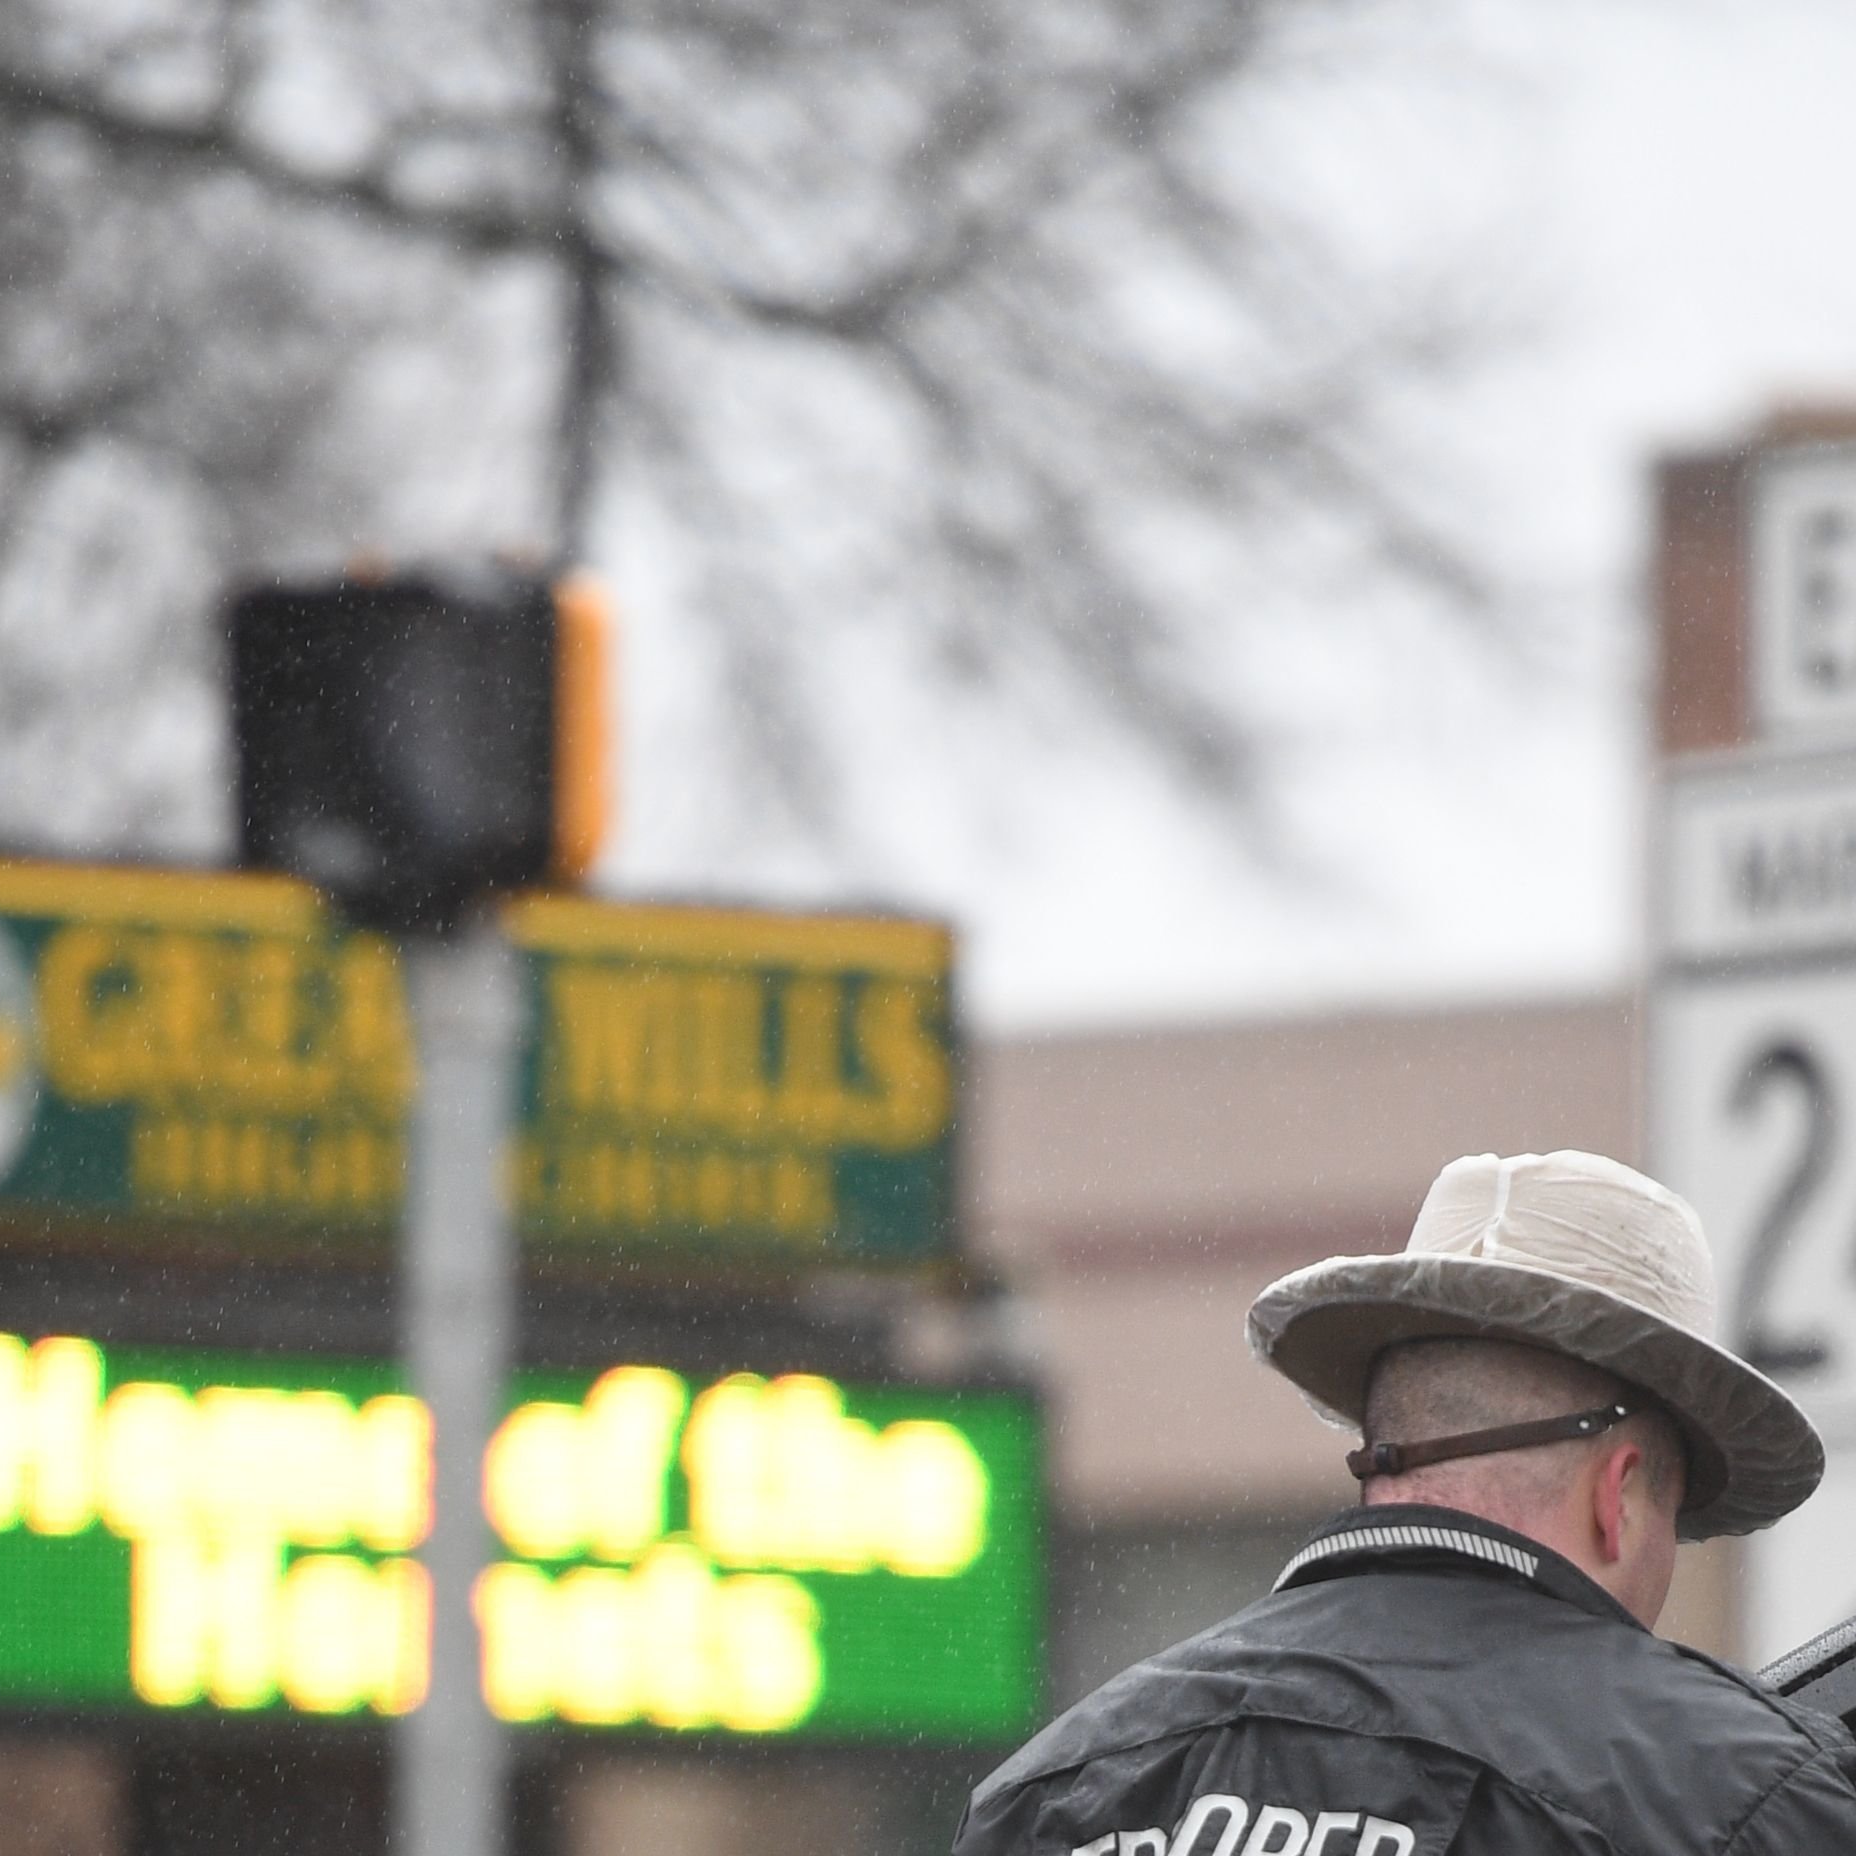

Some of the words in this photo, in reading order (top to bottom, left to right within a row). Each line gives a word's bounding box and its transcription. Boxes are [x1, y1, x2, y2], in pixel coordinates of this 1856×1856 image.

[34, 922, 419, 1118] GREA
[484, 1366, 687, 1562] of
[686, 1373, 988, 1578] the
